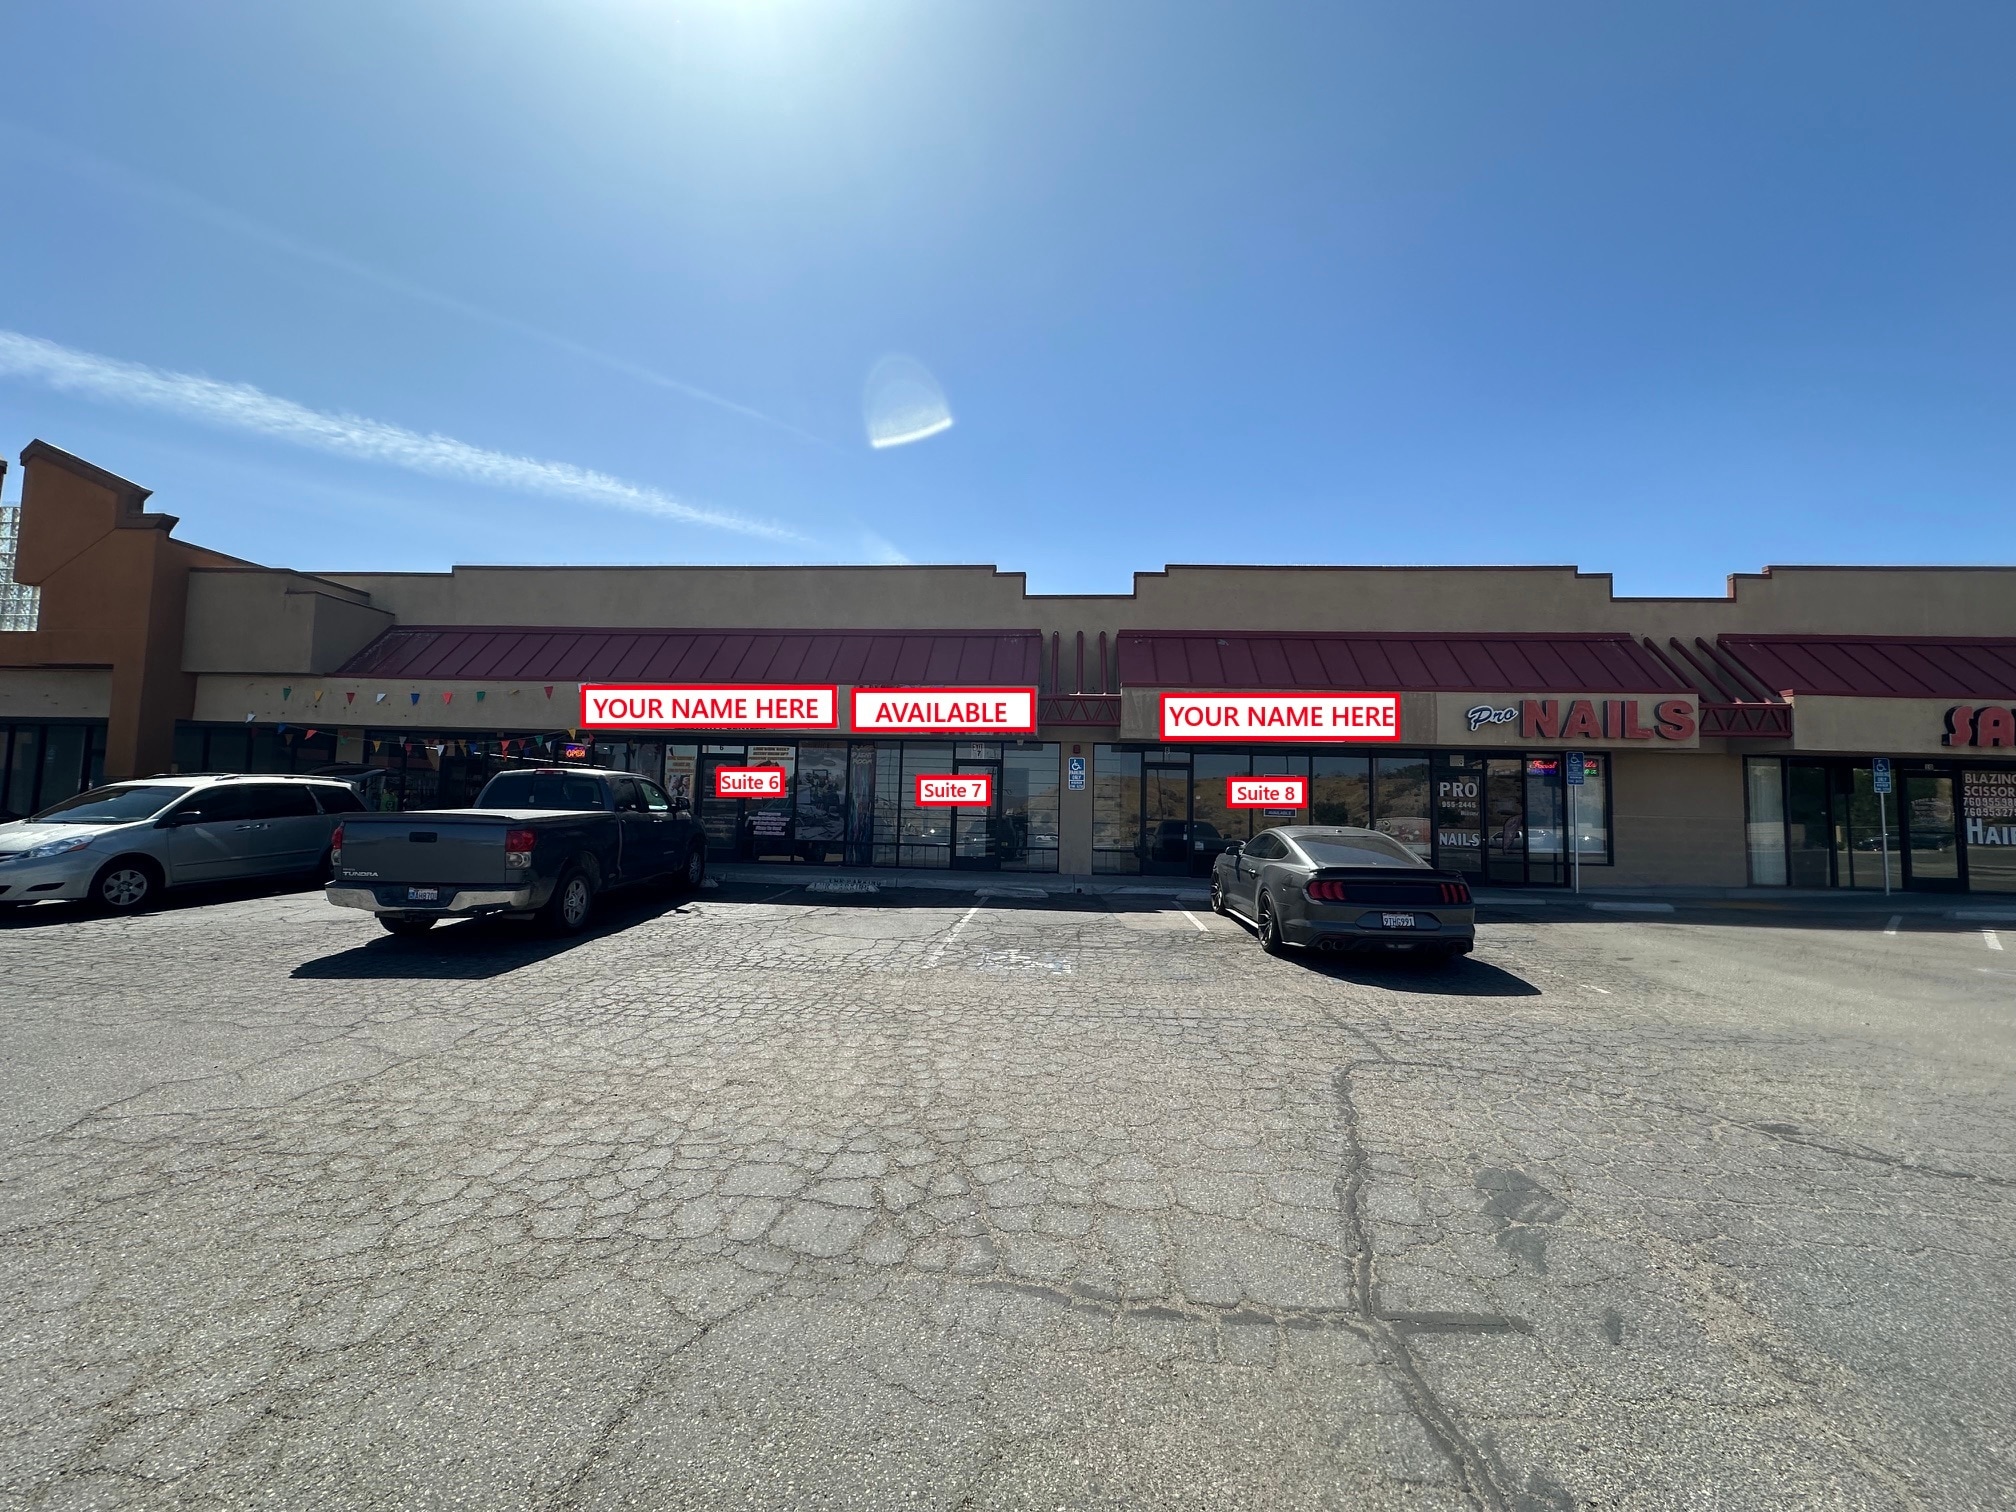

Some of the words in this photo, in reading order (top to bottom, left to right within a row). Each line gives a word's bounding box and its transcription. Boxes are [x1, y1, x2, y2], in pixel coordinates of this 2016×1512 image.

[1467, 705, 1518, 731] Pro
[1520, 699, 1696, 740] NAILS
[1942, 706, 2016, 747] SA
[1439, 782, 1478, 798] PRO
[1439, 832, 1480, 847] NAILS
